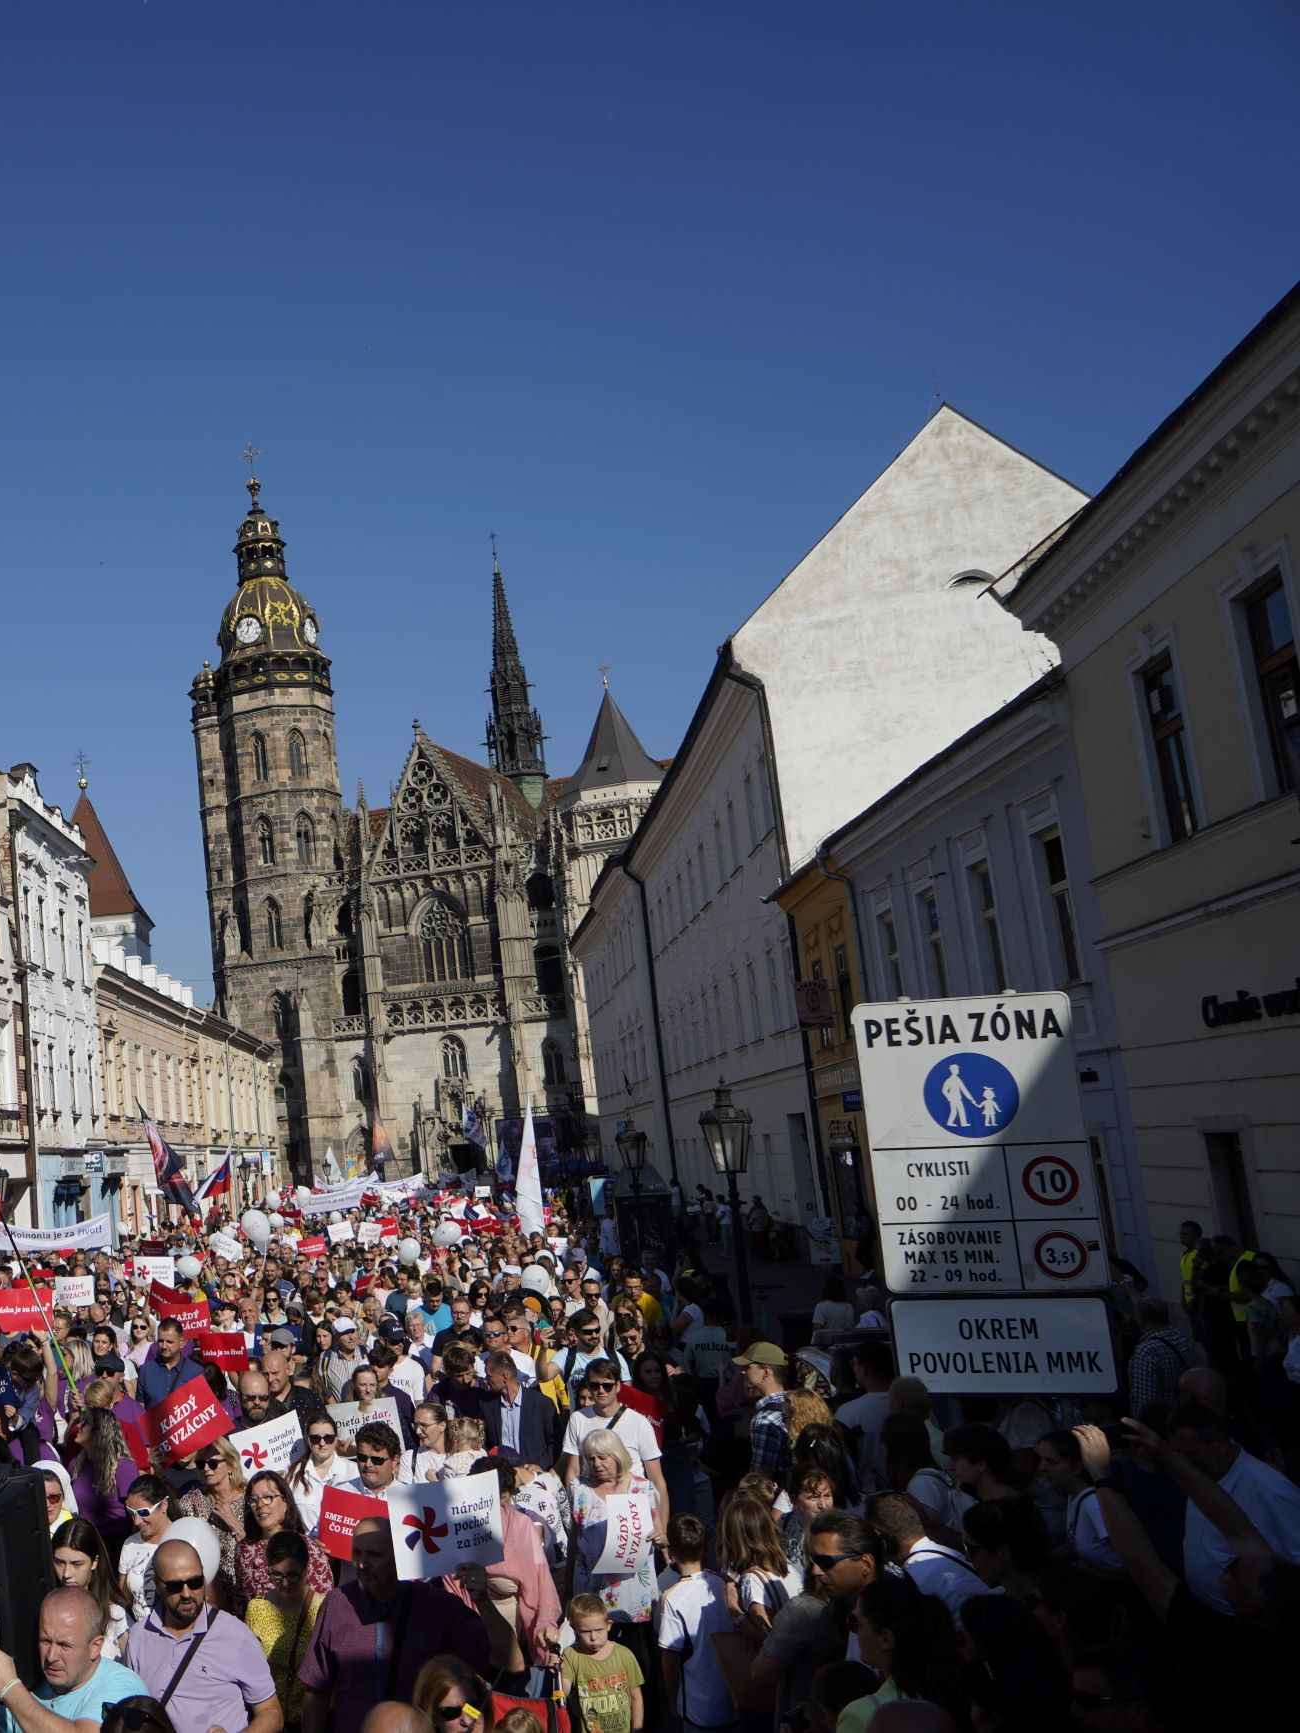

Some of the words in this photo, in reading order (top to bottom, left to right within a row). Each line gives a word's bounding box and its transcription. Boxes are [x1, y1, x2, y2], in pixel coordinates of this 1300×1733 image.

[864, 1009, 961, 1048] PEŠIA
[967, 1003, 1064, 1042] ZÓNA
[907, 1161, 970, 1177] CYKLISTI
[1035, 1169, 1067, 1193] 10
[896, 1196, 918, 1211] 00
[940, 1195, 960, 1210] 24
[966, 1194, 1000, 1210] hod.
[11, 1231, 50, 1239] Koinonia
[53, 1231, 61, 1240] je
[77, 1224, 102, 1236] život!
[897, 1229, 1002, 1246] ZÁSOBOVANIE
[904, 1251, 937, 1265] MAX
[941, 1251, 958, 1264] 15
[964, 1250, 1000, 1264] MIN.
[1046, 1248, 1077, 1267] 3,5t
[910, 1270, 927, 1282] 22
[945, 1270, 963, 1282] 09
[969, 1269, 1002, 1282] hod.
[63, 1282, 84, 1291] KAŽDÝ
[13, 1305, 21, 1316] je
[958, 1317, 1039, 1340] OKREM
[216, 1349, 223, 1357] je
[695, 1343, 730, 1351] POLÍCIA
[909, 1352, 1039, 1374] POVOLENIA
[1046, 1352, 1103, 1374] MMK
[160, 1394, 198, 1433] KAŽDÝ
[334, 1415, 360, 1430] Dieťa
[362, 1414, 370, 1425] je
[372, 1410, 391, 1421] dar,
[169, 1404, 218, 1445] VZÁCNY
[268, 1426, 296, 1444] národný
[271, 1437, 294, 1454] pochod
[451, 1494, 494, 1515] národný
[325, 1512, 342, 1522] SME
[453, 1513, 490, 1533] pochod
[329, 1522, 340, 1533] ČO
[628, 1500, 642, 1557] VZÁCNY
[457, 1537, 471, 1549] za
[473, 1530, 493, 1546] život
[615, 1514, 628, 1560] KAŽDÝ
[624, 1557, 634, 1568] JE
